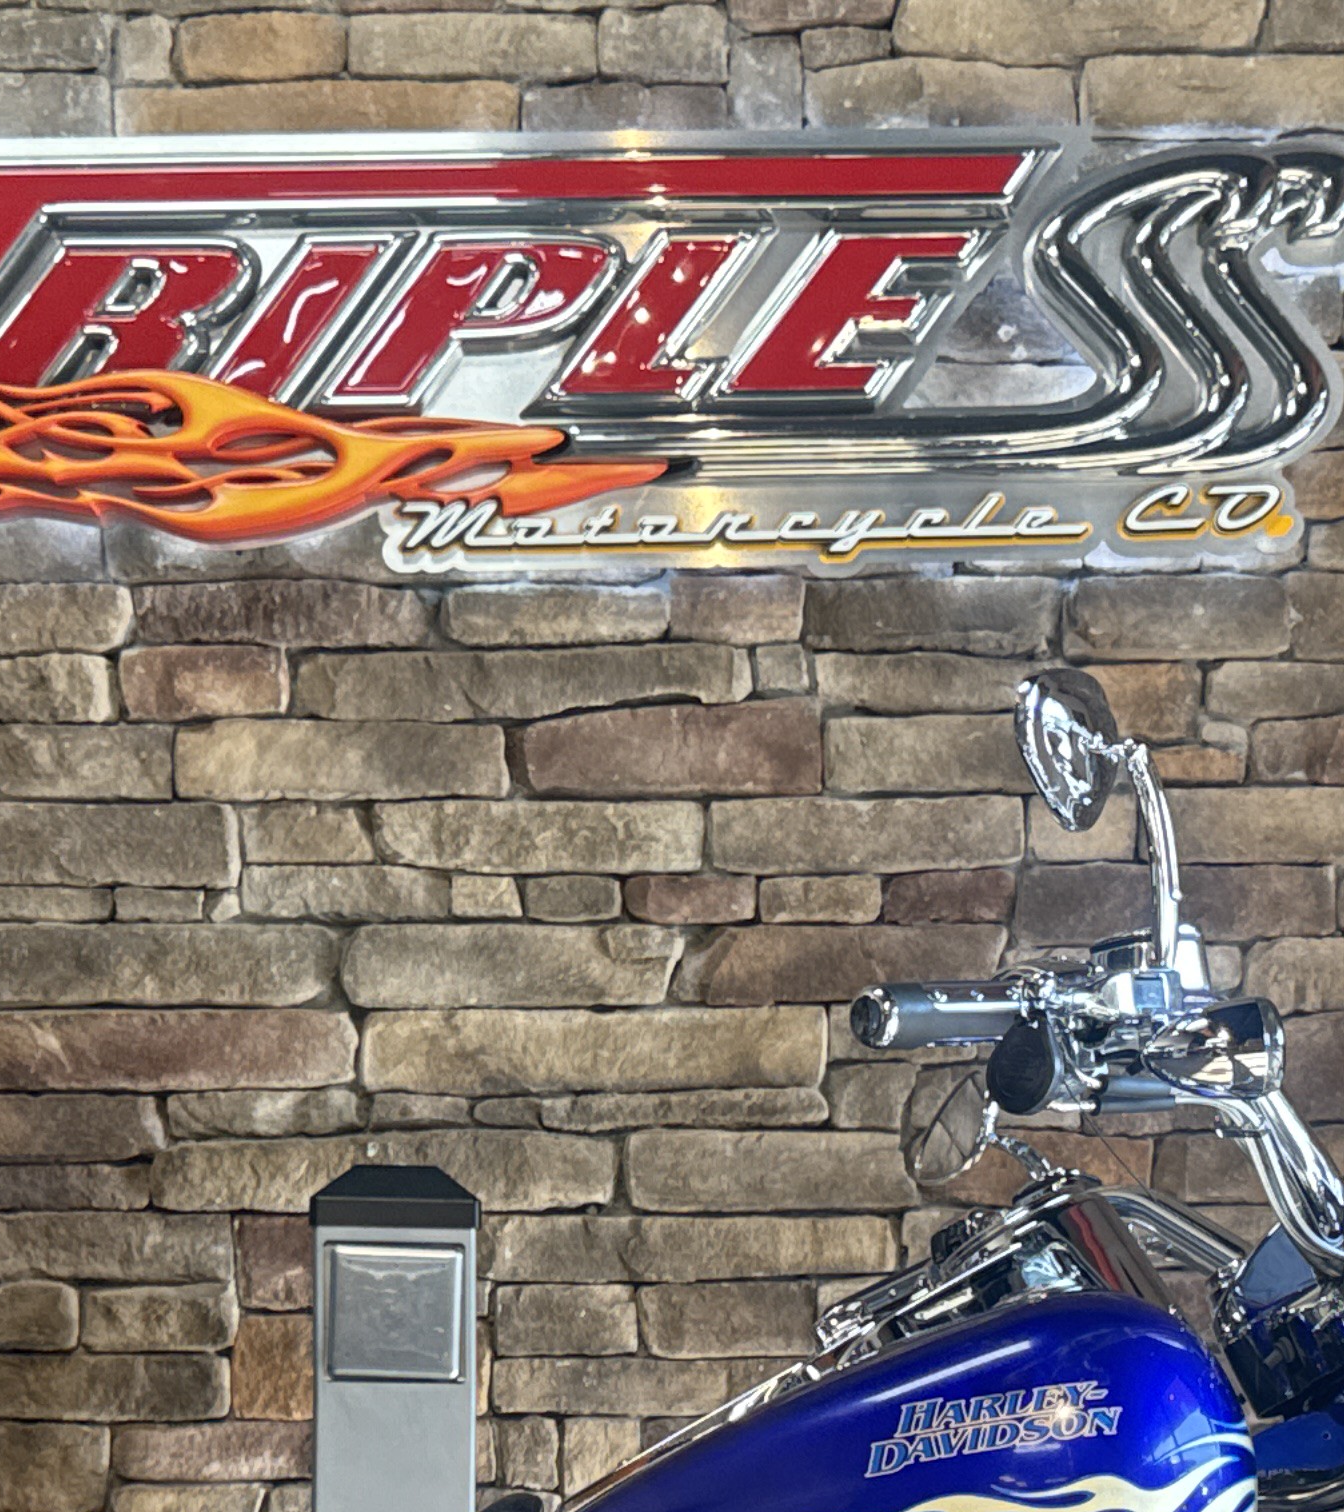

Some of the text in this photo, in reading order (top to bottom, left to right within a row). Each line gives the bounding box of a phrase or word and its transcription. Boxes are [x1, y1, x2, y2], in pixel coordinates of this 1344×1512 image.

[396, 492, 1091, 564] Motorcycle
[863, 1406, 1123, 1478] DAVIDSON
[893, 1380, 1109, 1439] HARLEY-
